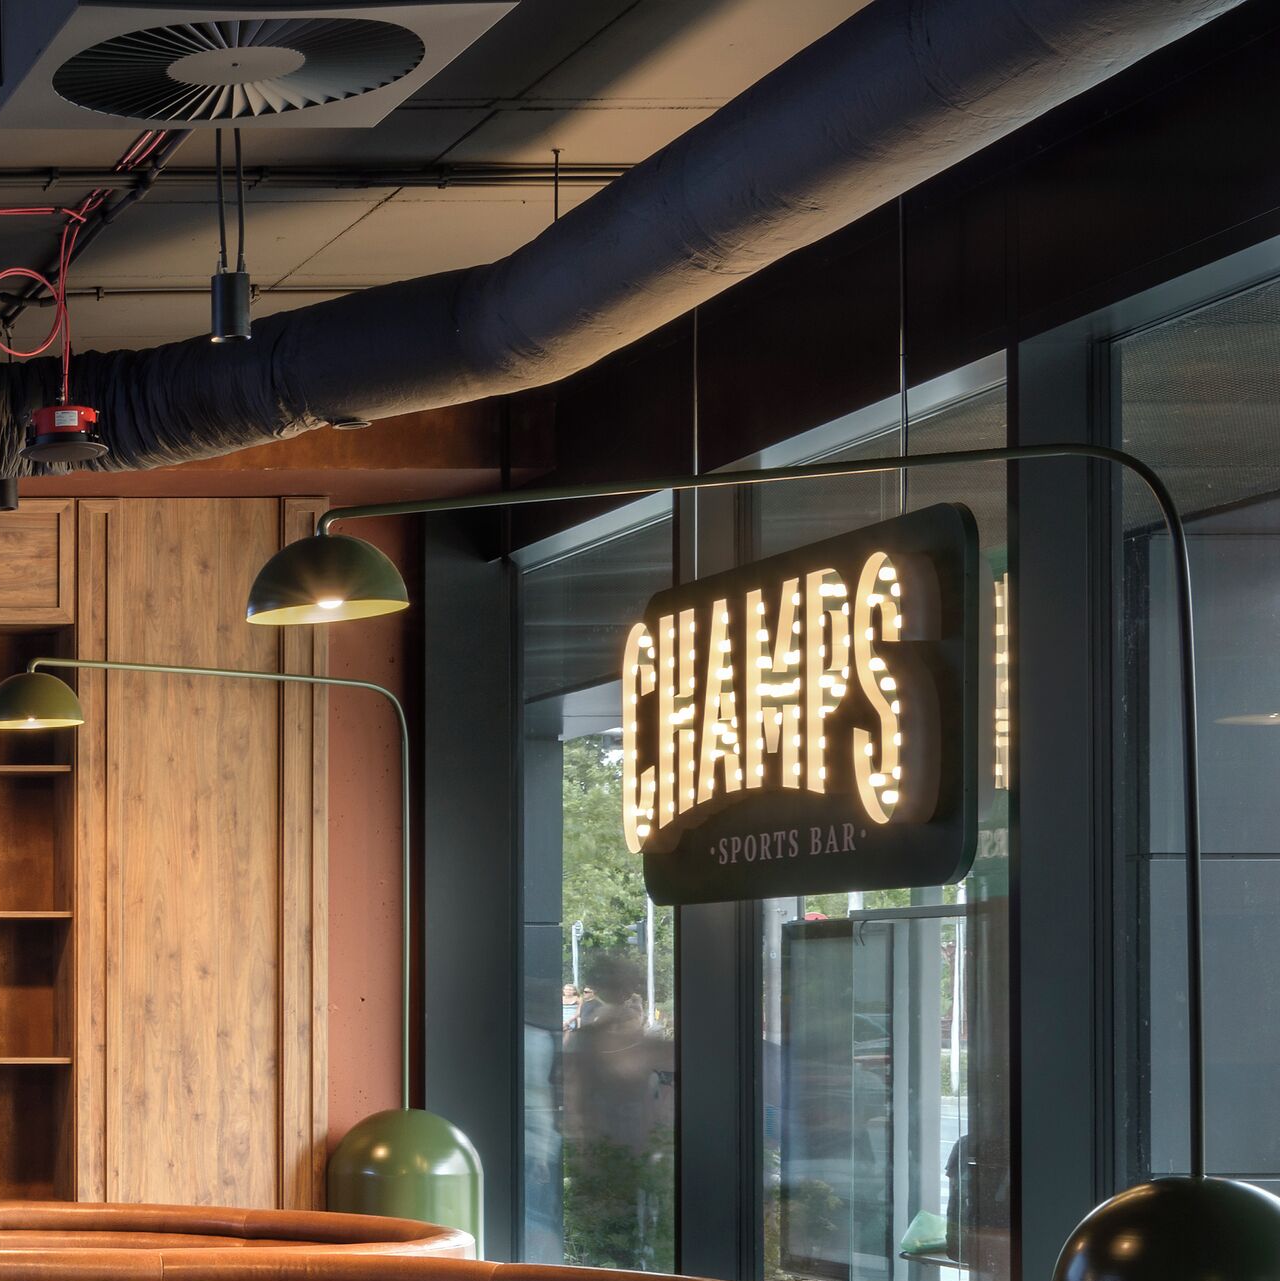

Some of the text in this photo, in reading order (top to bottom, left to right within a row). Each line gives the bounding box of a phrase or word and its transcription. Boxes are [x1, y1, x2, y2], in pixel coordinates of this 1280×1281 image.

[622, 551, 903, 854] CHAMPS
[718, 822, 857, 865] SPORTS BAR
